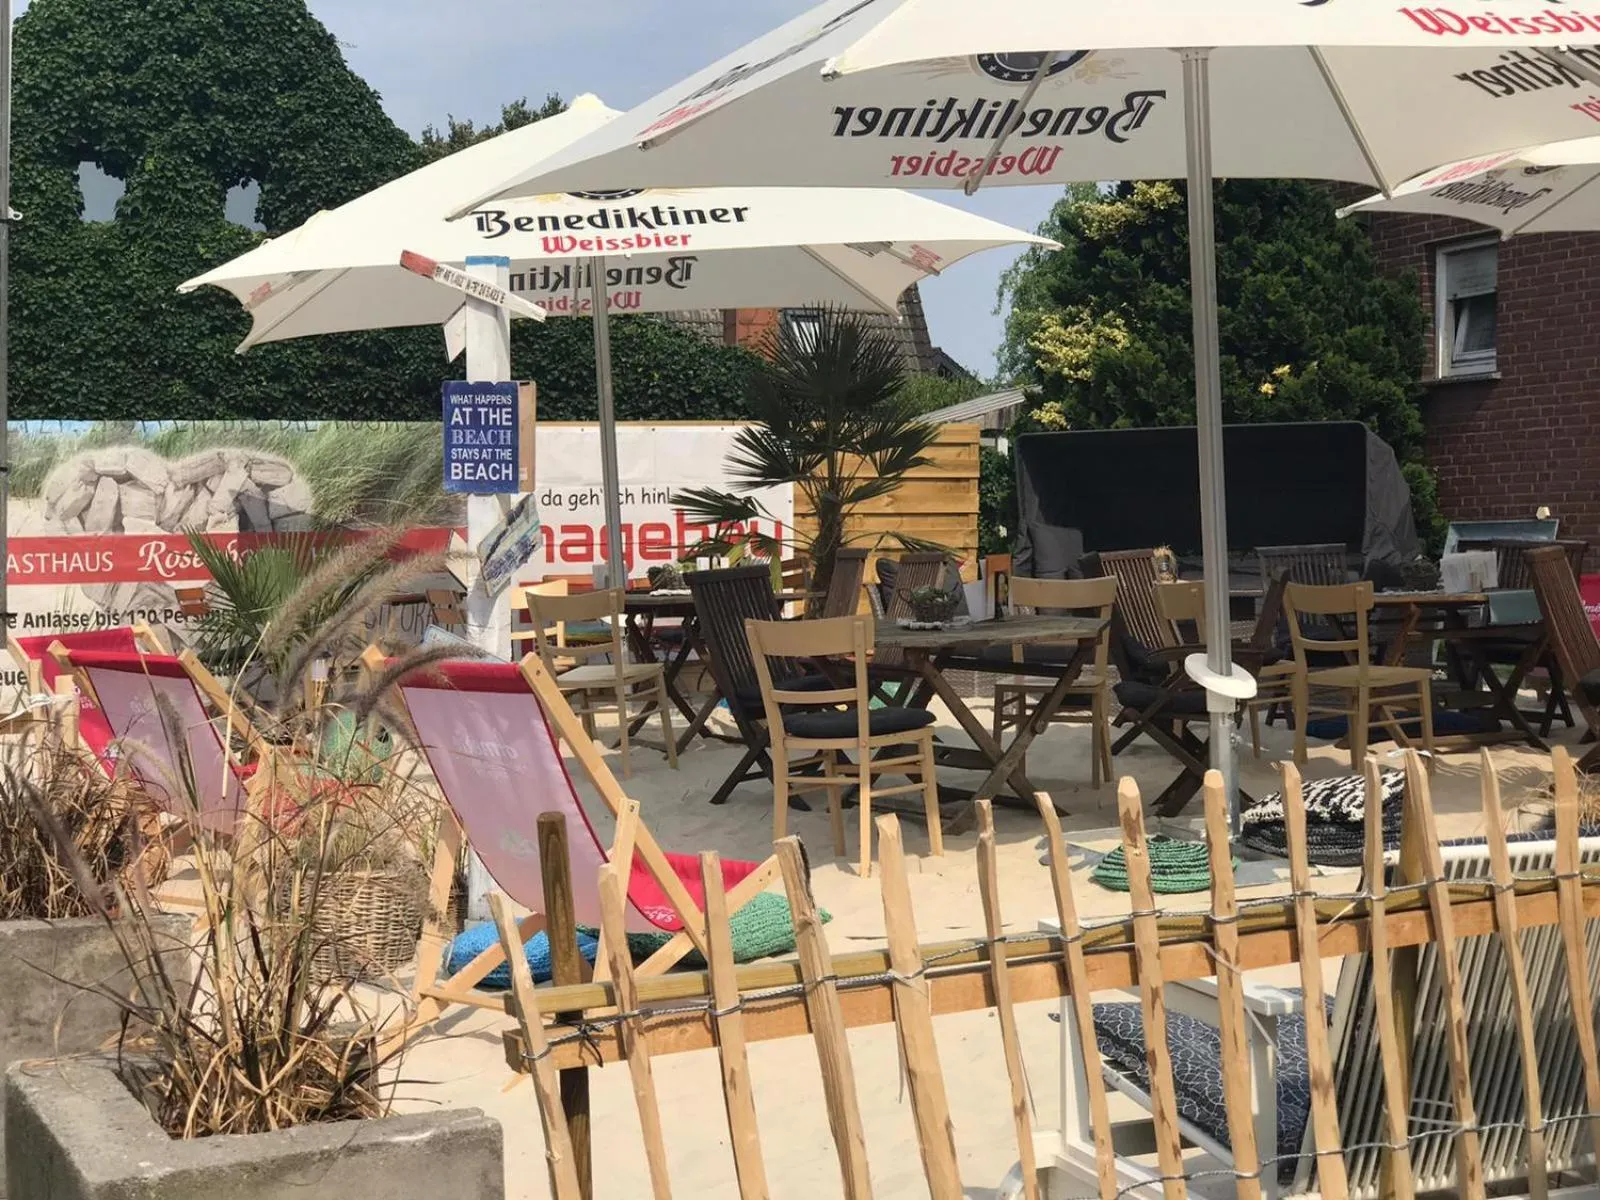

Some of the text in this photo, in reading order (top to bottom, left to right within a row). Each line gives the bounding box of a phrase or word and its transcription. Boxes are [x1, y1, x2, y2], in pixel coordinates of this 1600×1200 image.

[470, 204, 750, 239] Benediktiner
[540, 231, 692, 255] Weissbier
[450, 395, 513, 405] WHAT HAPPENS
[451, 407, 513, 426] AT THE
[451, 428, 513, 446] BEACH
[451, 448, 513, 460] STAYS AT THE
[451, 462, 513, 481] BEACH
[541, 488, 563, 507] da
[7, 551, 114, 574] ASTHAUS
[23, 610, 89, 629] Anlässe
[96, 609, 120, 627] bis
